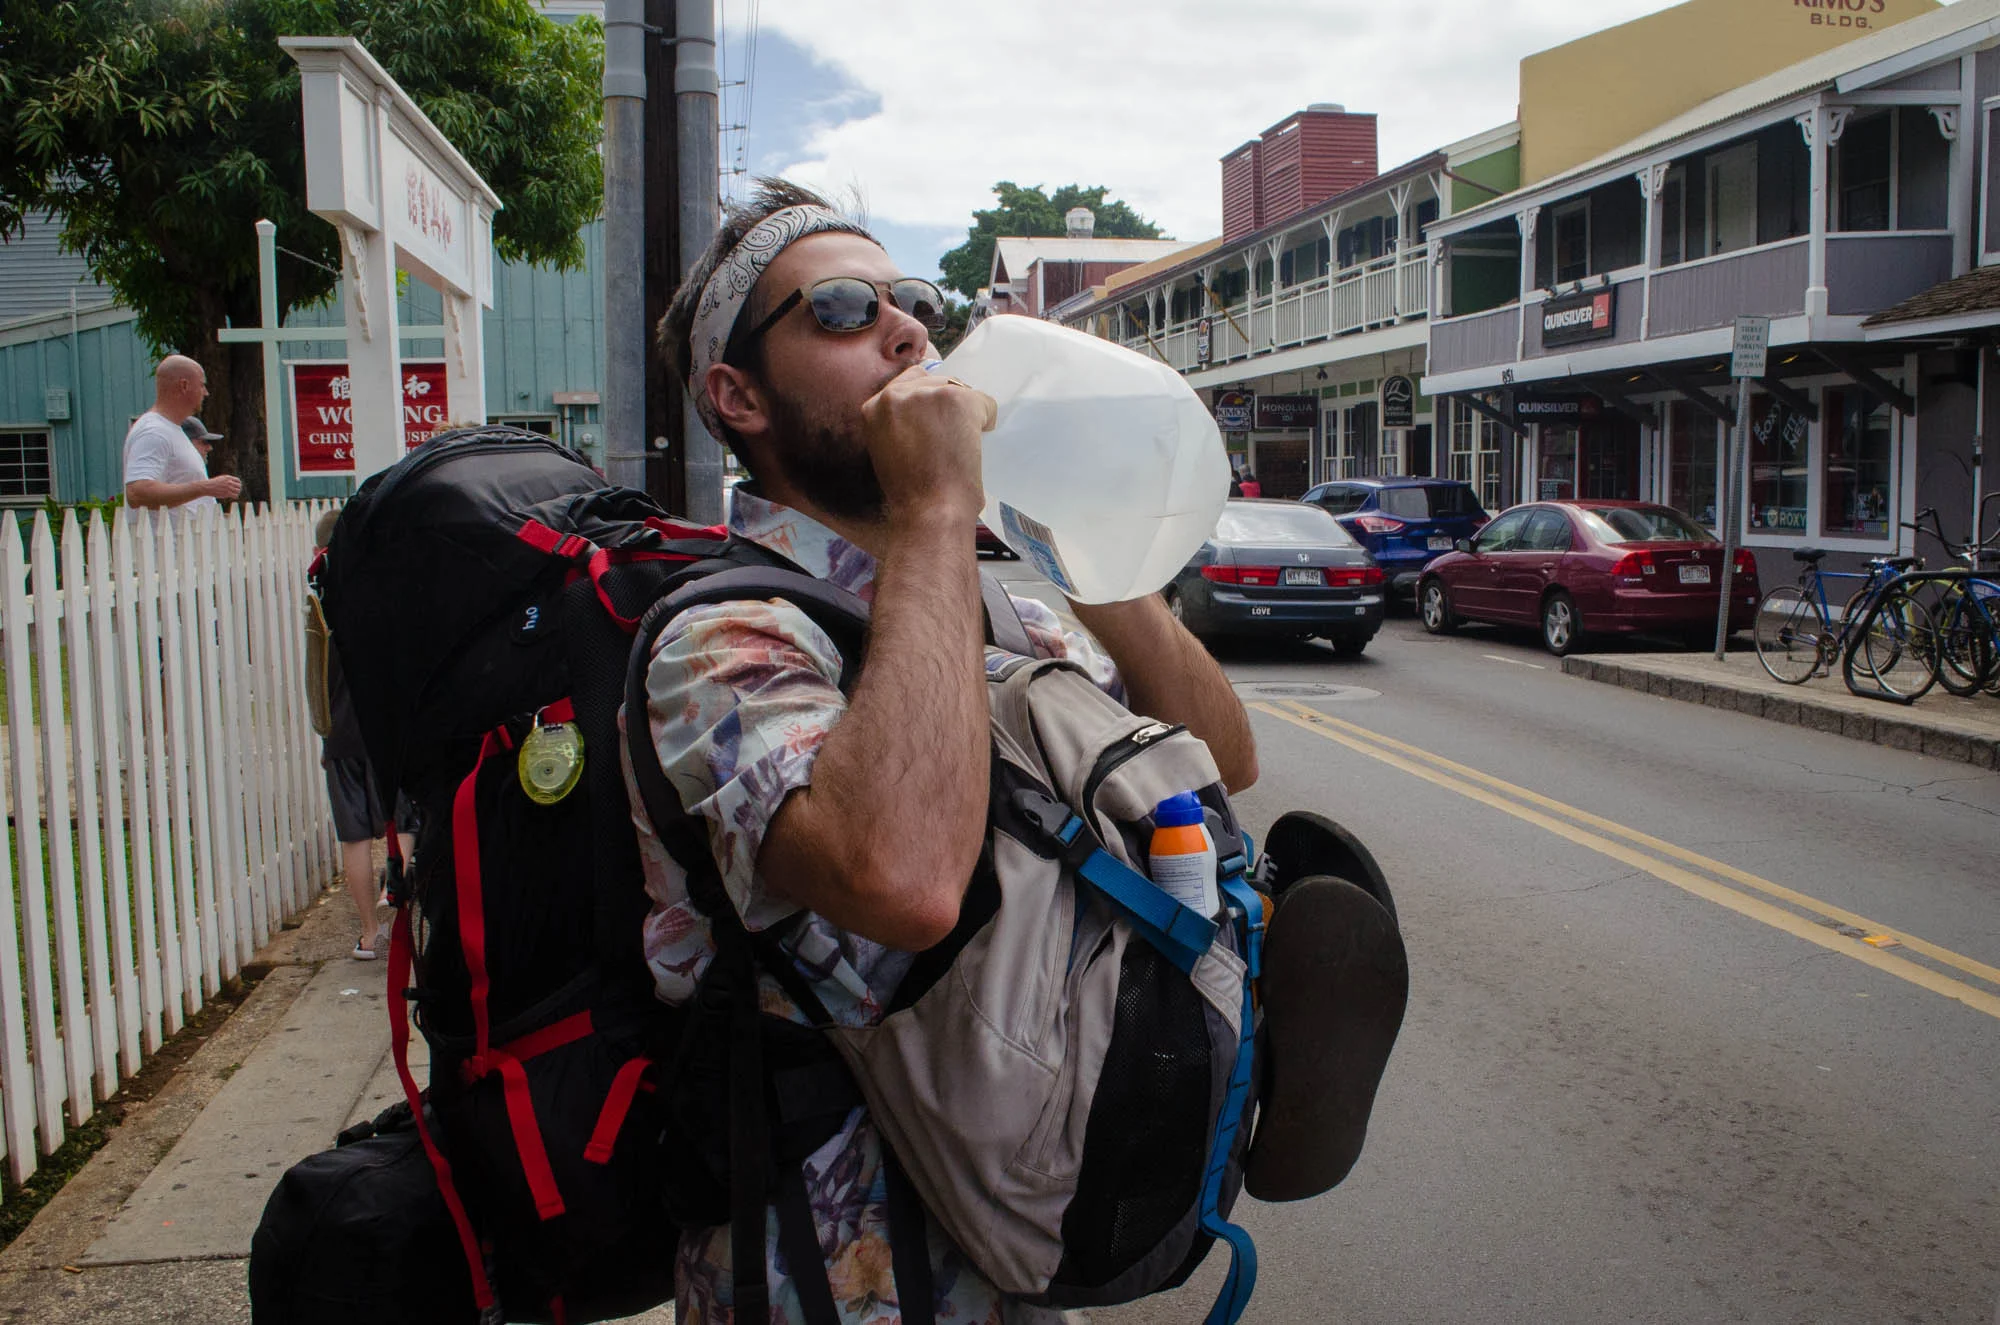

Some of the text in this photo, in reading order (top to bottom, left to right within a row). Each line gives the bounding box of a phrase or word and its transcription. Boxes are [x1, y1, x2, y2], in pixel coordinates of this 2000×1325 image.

[1810, 13, 1873, 29] BLDG.
[1544, 306, 1593, 330] QUIKSILVER
[1502, 368, 1515, 384] 851
[1518, 402, 1579, 414] QUIKSILVER
[333, 448, 346, 459] &
[1779, 513, 1807, 526] ROXY
[1251, 607, 1271, 616] LOVE
